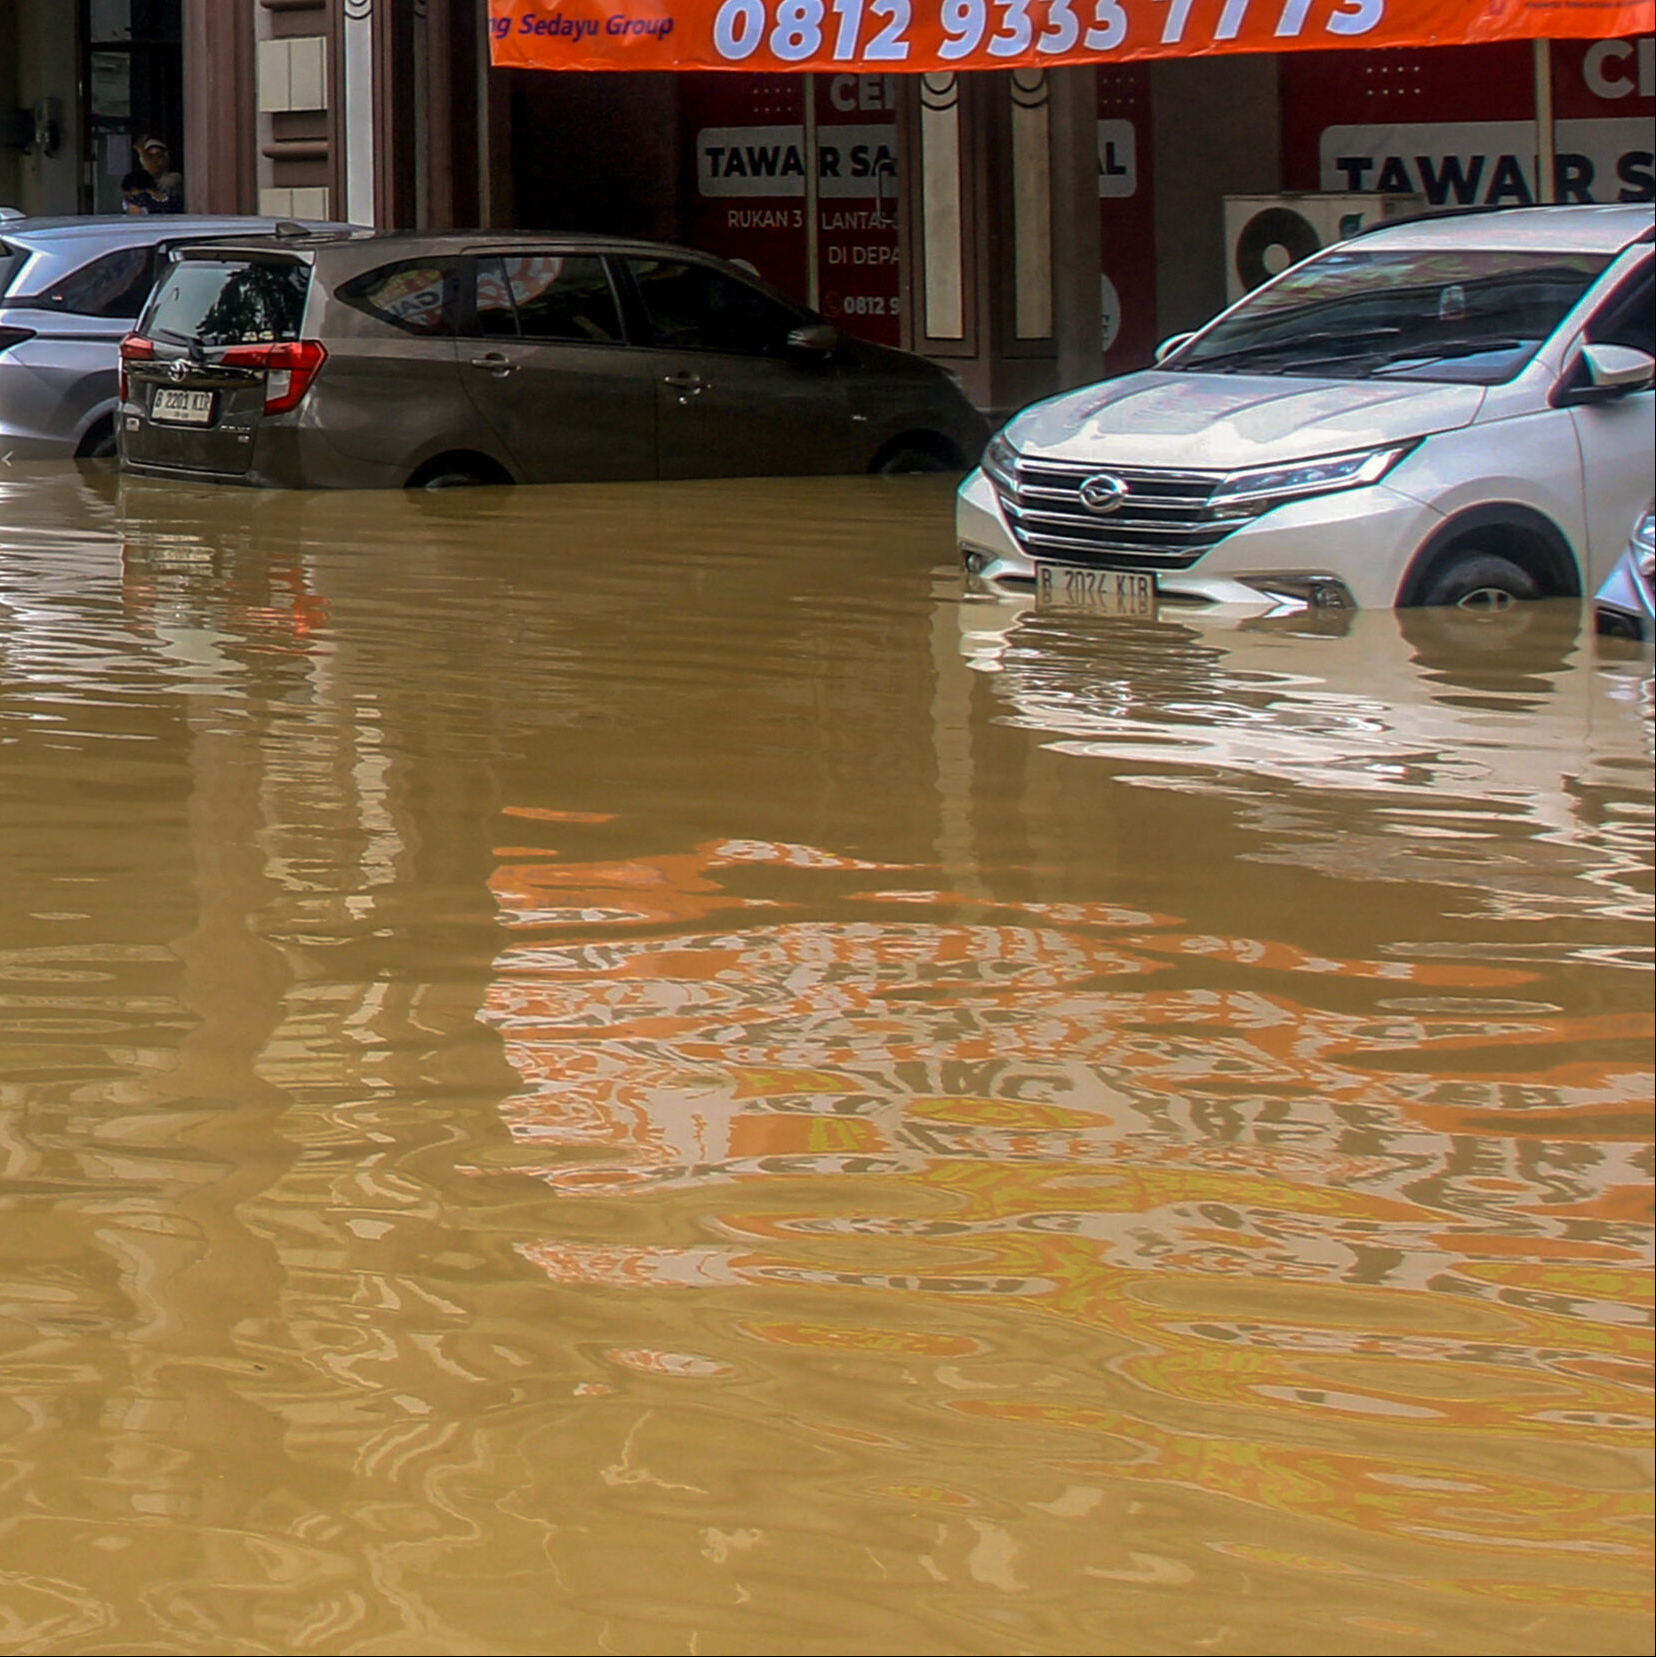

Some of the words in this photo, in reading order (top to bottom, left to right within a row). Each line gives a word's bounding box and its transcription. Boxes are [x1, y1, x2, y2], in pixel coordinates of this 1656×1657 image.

[518, 13, 599, 41] Sedayu
[605, 14, 675, 41] Group
[705, 145, 841, 179] TAWAR
[1335, 153, 1596, 206] TAWAR
[727, 210, 788, 229] RUKAN
[792, 211, 804, 228] 3
[828, 246, 848, 264] DI
[843, 296, 886, 316] 0812
